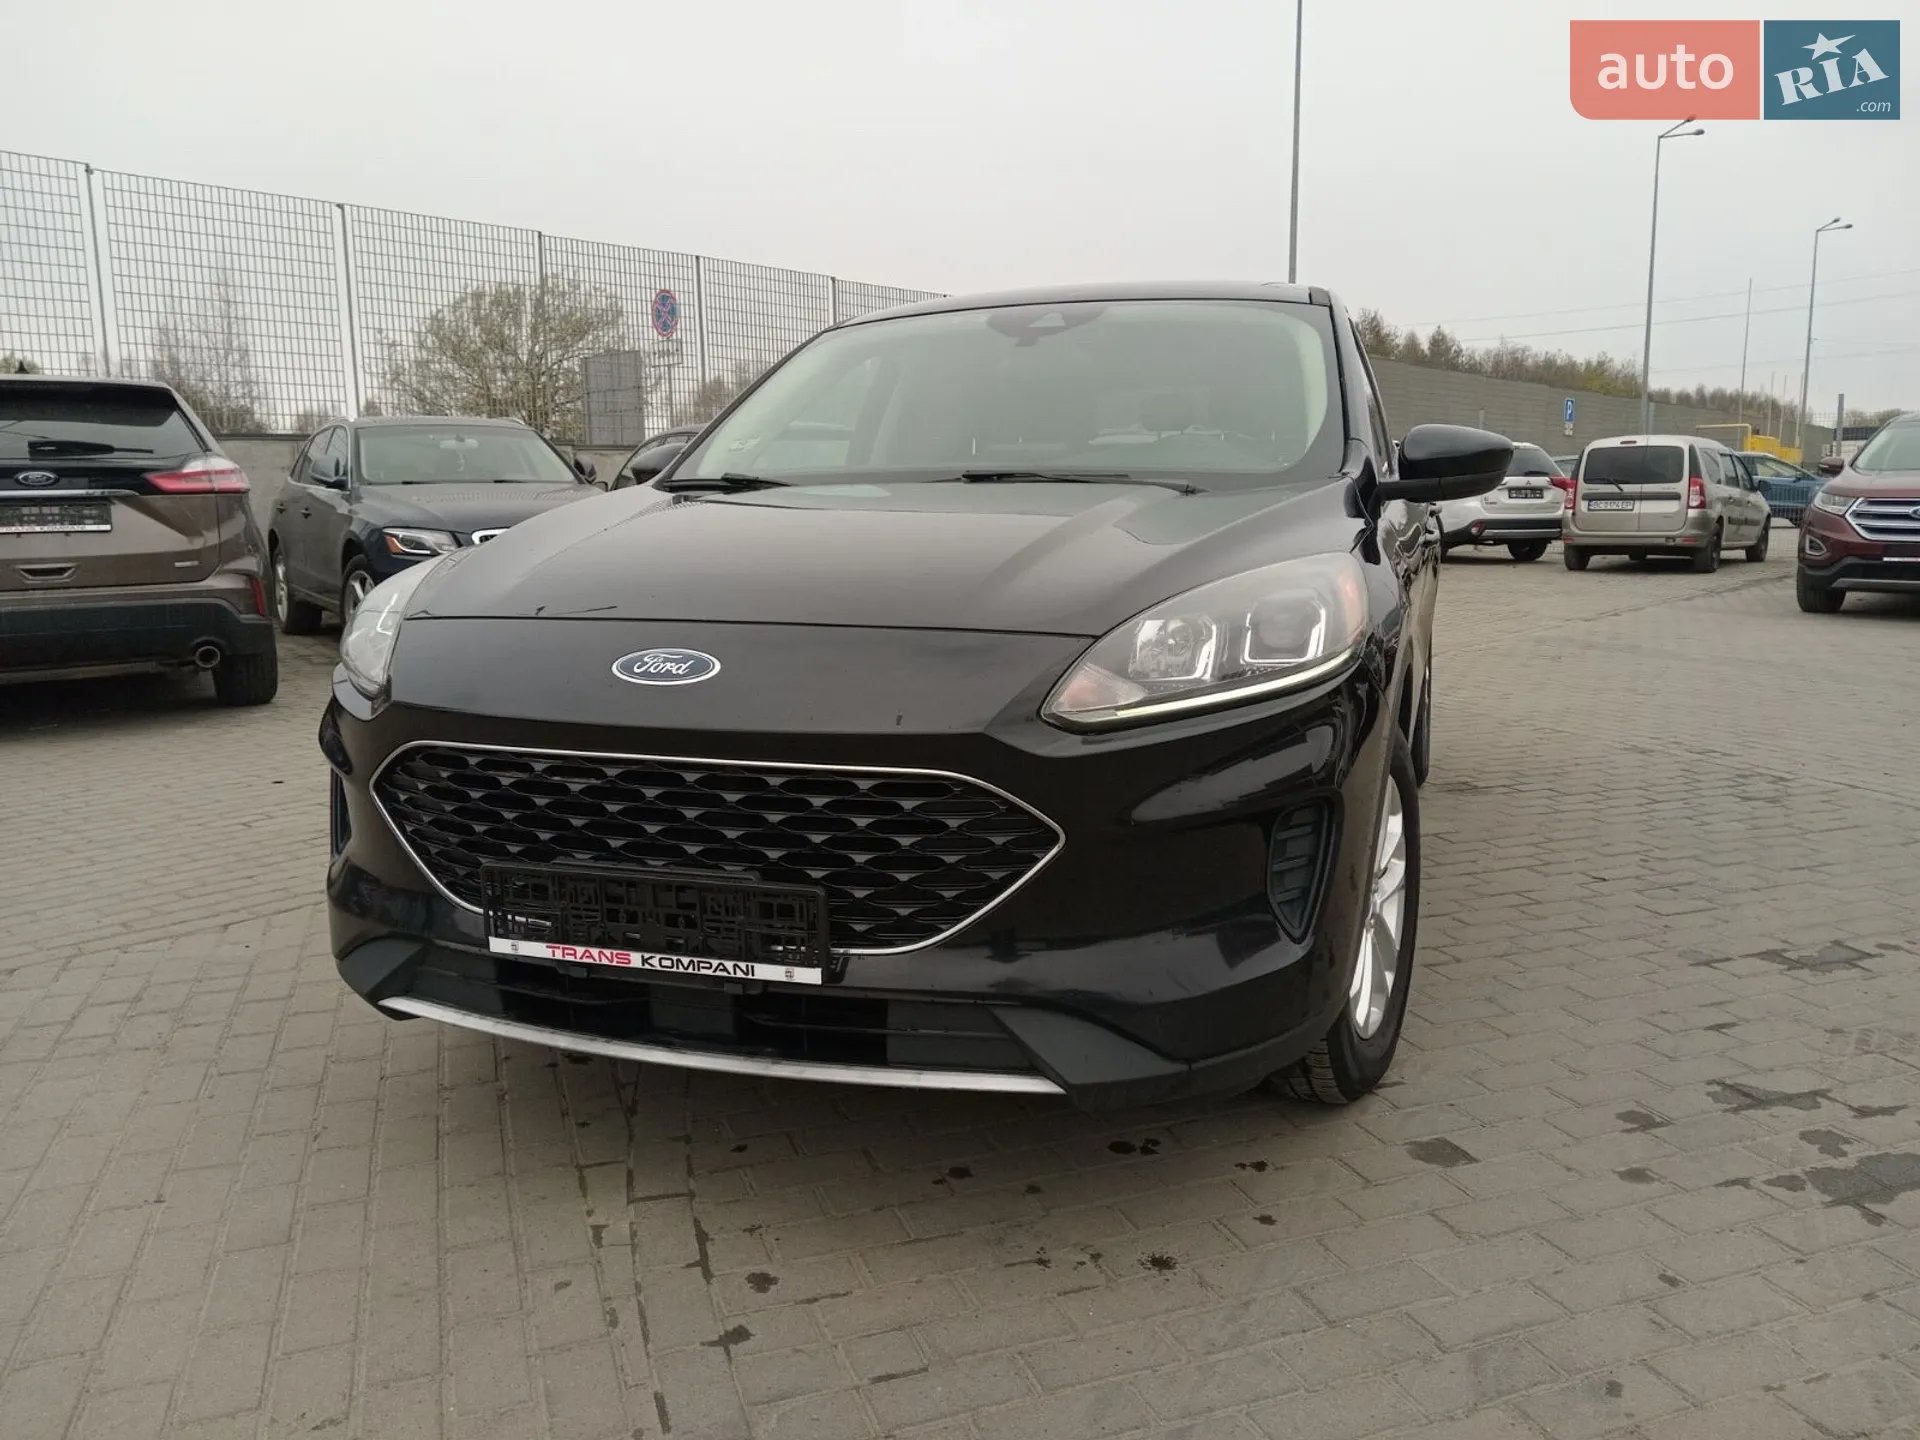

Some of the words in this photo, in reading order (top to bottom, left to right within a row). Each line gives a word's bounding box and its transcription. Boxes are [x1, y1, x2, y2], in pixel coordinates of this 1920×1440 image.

[633, 653, 694, 675] Ford
[546, 944, 631, 966] TRANS
[641, 955, 755, 977] KOMPANI
